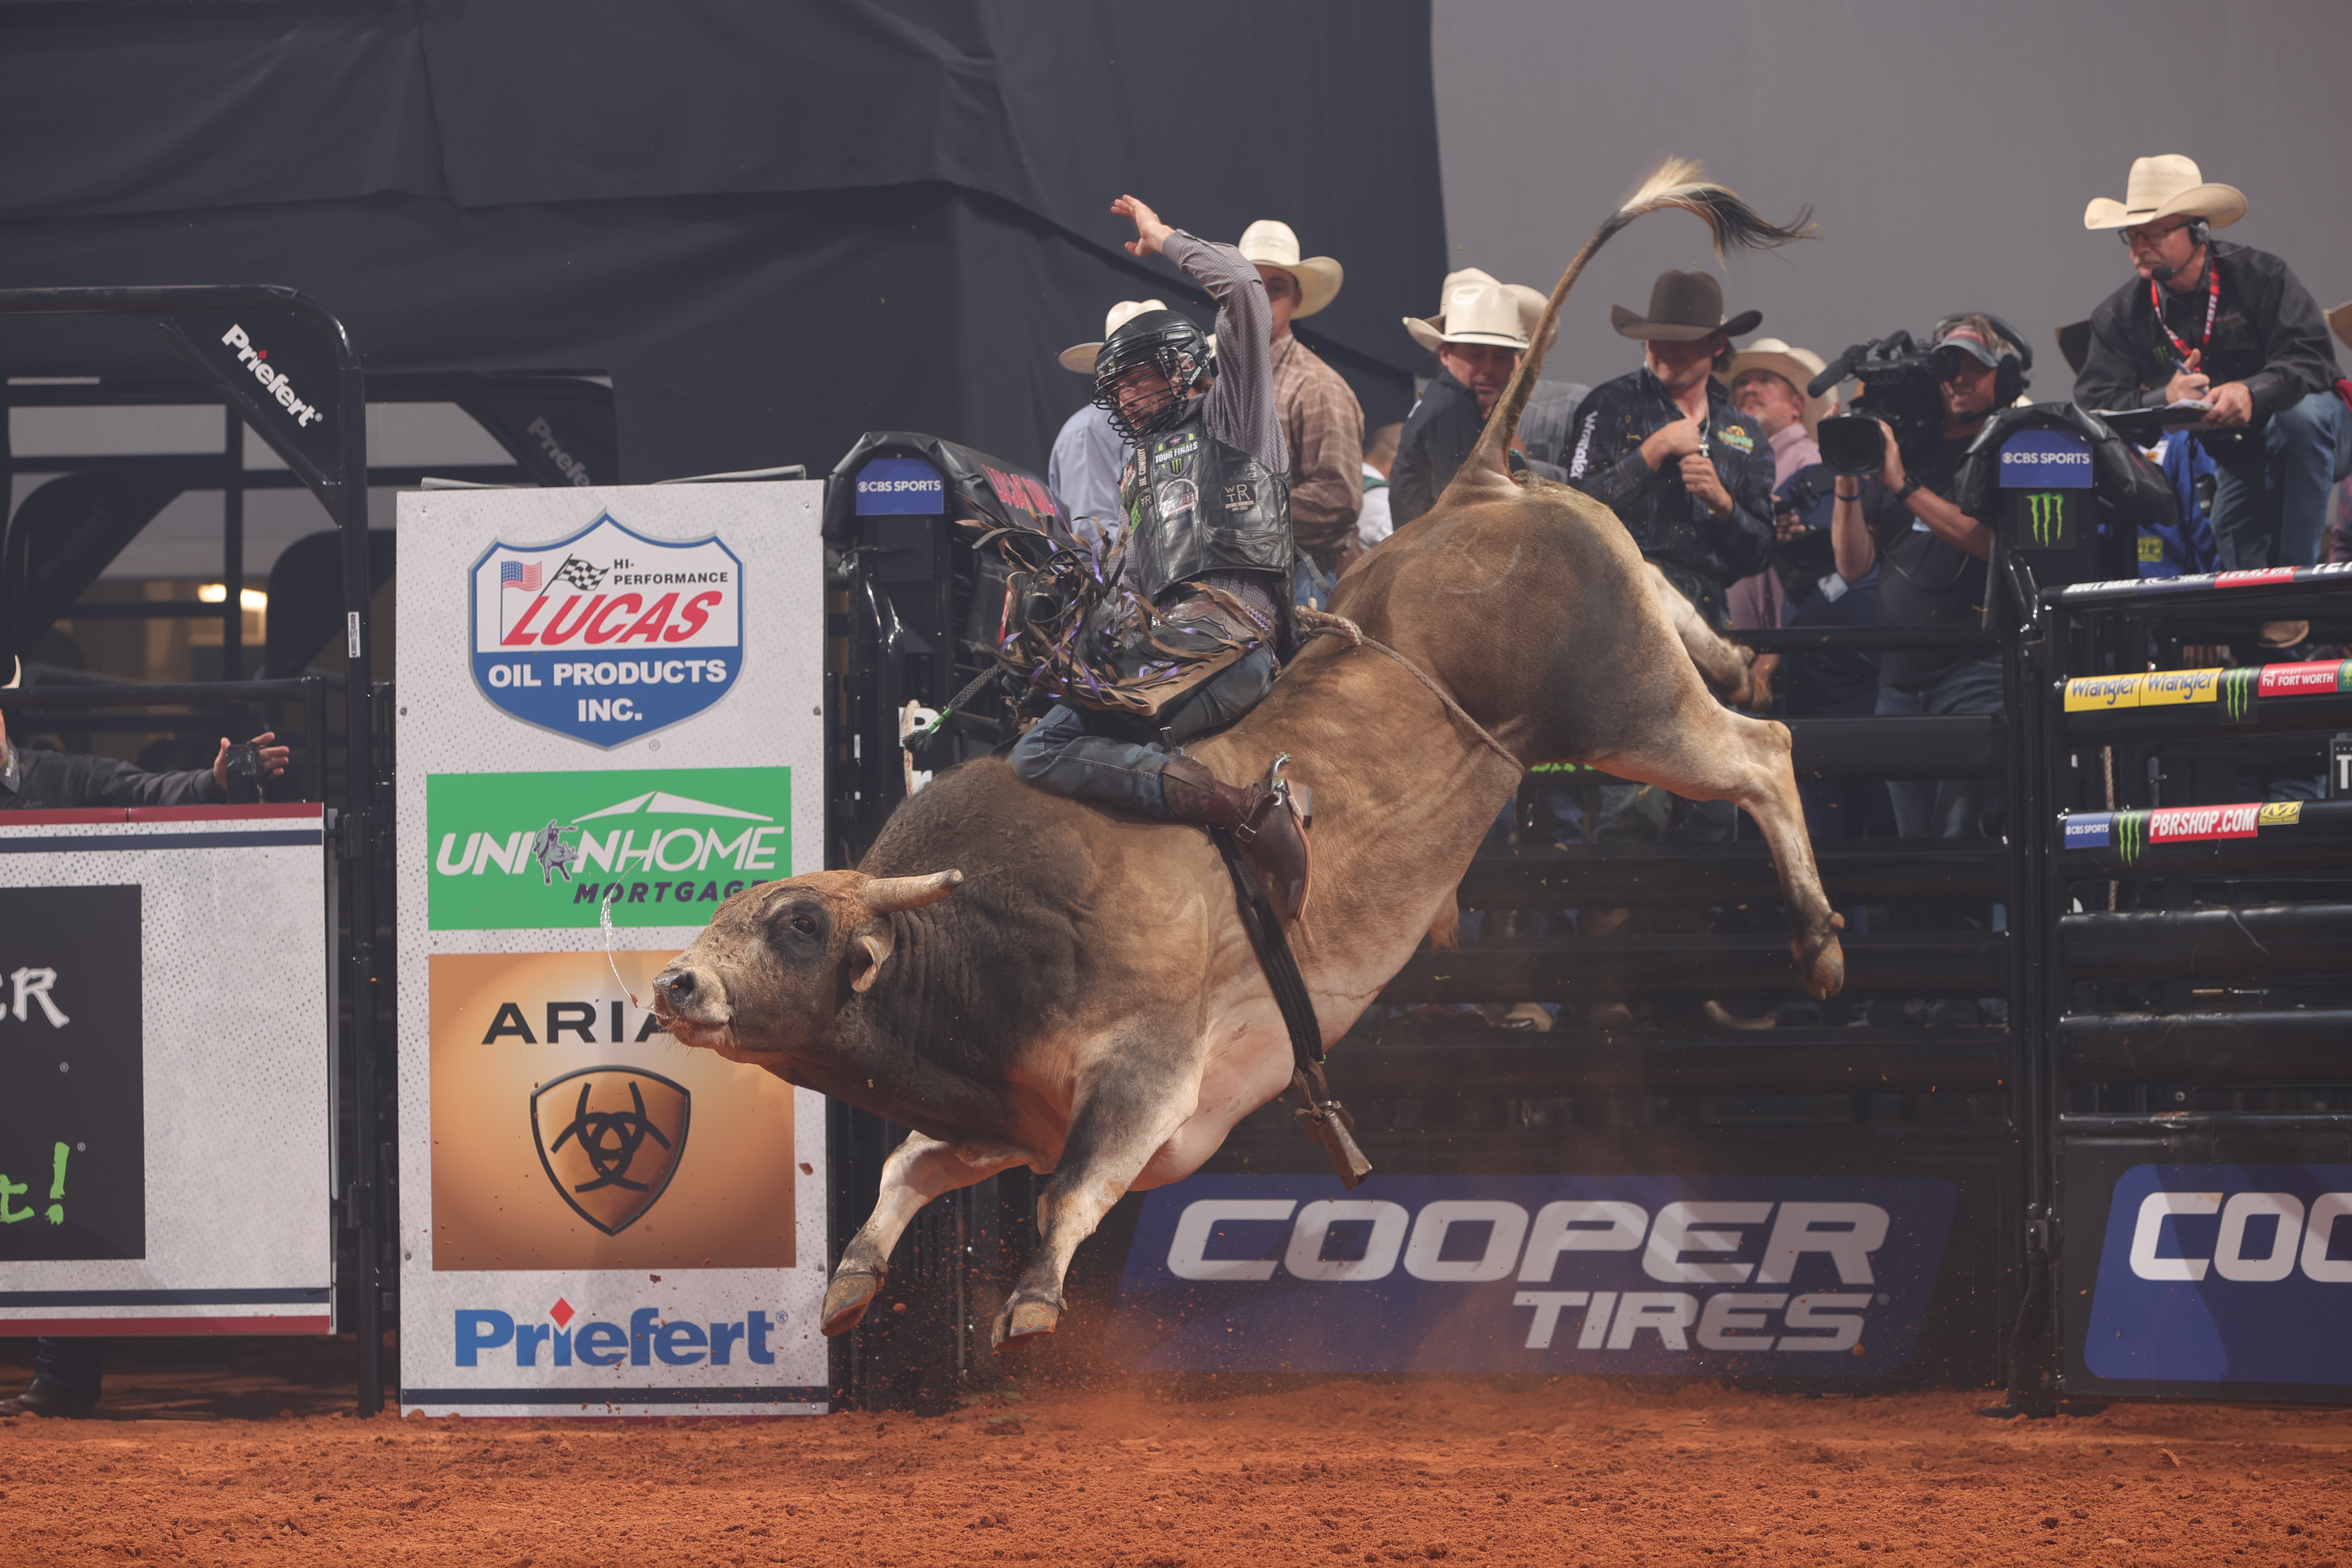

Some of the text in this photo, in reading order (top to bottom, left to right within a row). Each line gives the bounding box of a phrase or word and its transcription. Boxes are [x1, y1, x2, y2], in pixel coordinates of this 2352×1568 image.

[1155, 441, 1198, 463] TOUR FINALS
[2013, 452, 2090, 464] CBS SPORTS
[1137, 448, 1148, 487] BE COWBOY
[867, 480, 941, 492] CBS SPORTS
[614, 559, 634, 570] HI-
[614, 571, 728, 585] PERFORMANCE
[500, 591, 723, 646] LUCAS
[488, 659, 727, 687] OIL PRODUCTS
[2148, 671, 2215, 700] Wrangler
[2278, 675, 2301, 686] FORT
[2301, 672, 2334, 685] WORTH
[2072, 676, 2138, 705] Wrangler
[578, 698, 643, 722] INC.
[2071, 823, 2109, 835] CBS SPORTS
[2150, 808, 2259, 837] PBRSHOP.COM
[573, 880, 769, 904] MORTGAG
[1166, 1199, 1890, 1285] COOPER
[455, 1298, 775, 1367] Priefert
[1512, 1291, 1875, 1352] TIRES
